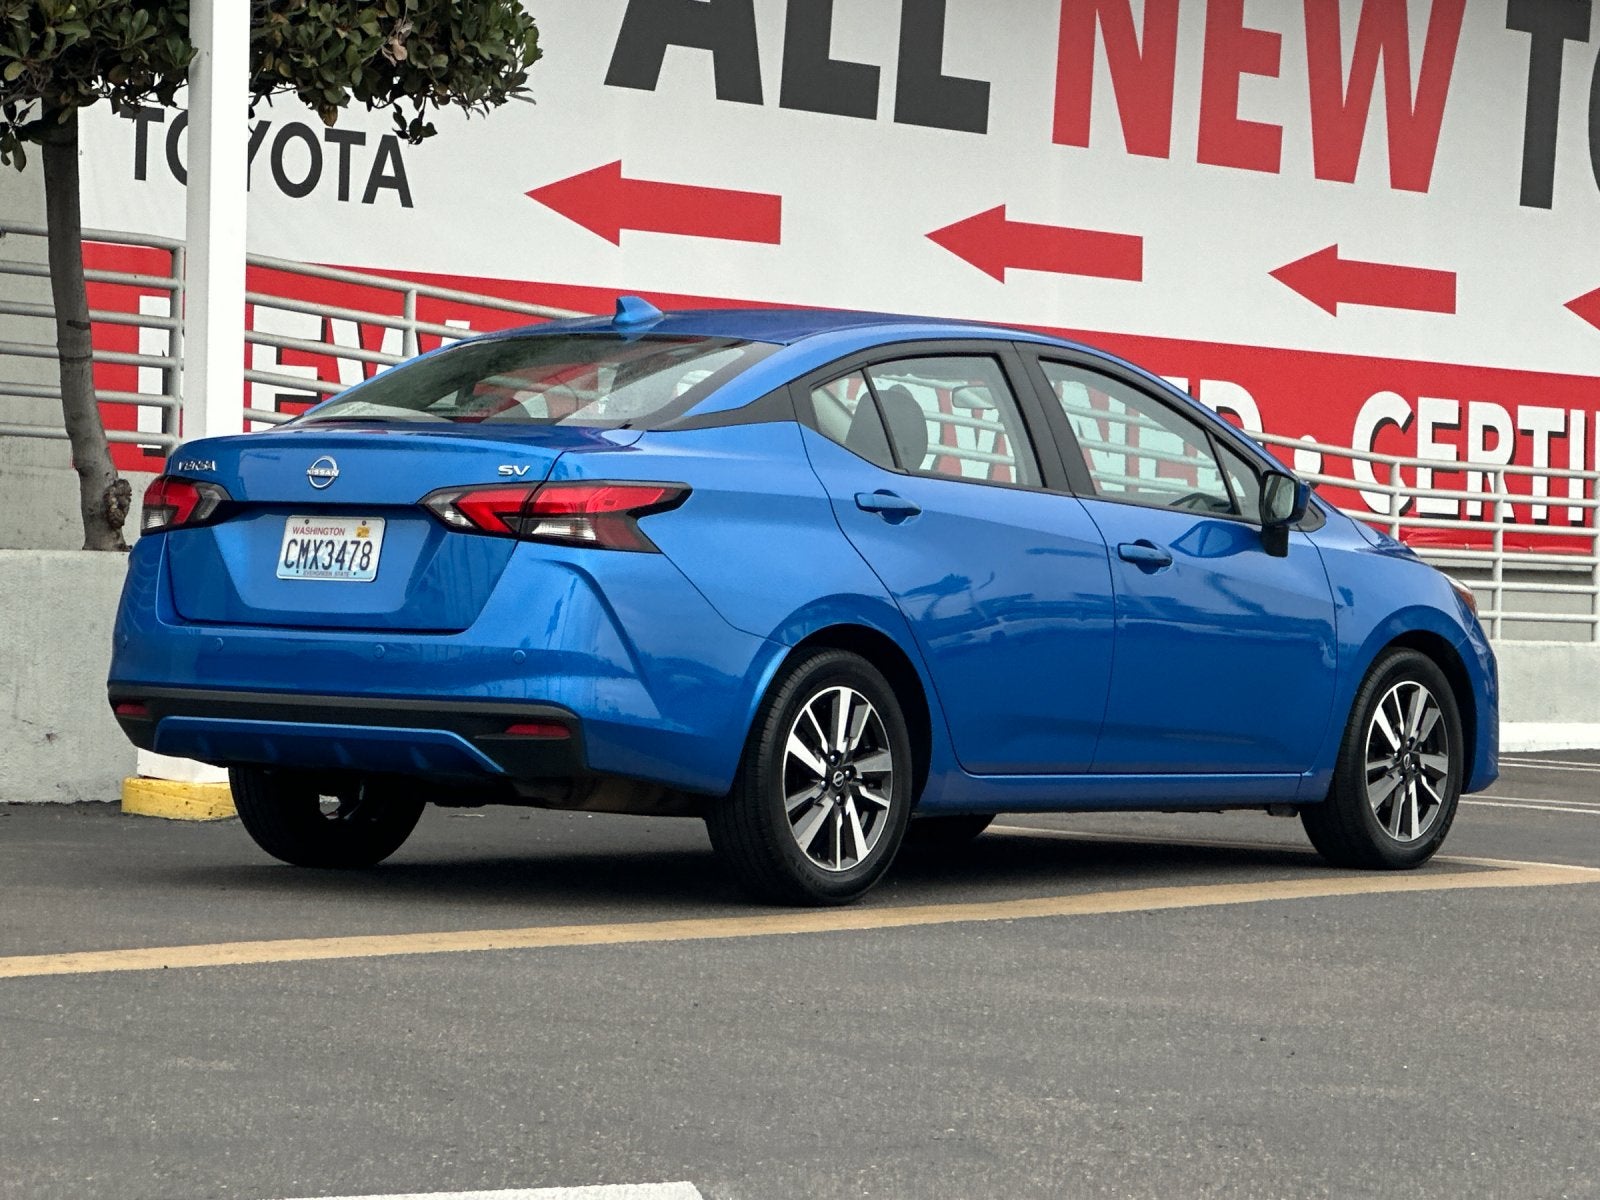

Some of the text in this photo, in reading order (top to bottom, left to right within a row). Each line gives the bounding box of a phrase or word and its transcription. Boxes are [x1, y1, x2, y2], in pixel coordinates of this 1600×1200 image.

[1052, 0, 1466, 193] NEW
[1506, 0, 1600, 210] T
[1352, 391, 1600, 524] CERTI
[307, 468, 339, 477] NISSAN
[498, 465, 530, 475] SV
[293, 527, 346, 536] WASHINGTON
[284, 538, 373, 571] CMX3478
